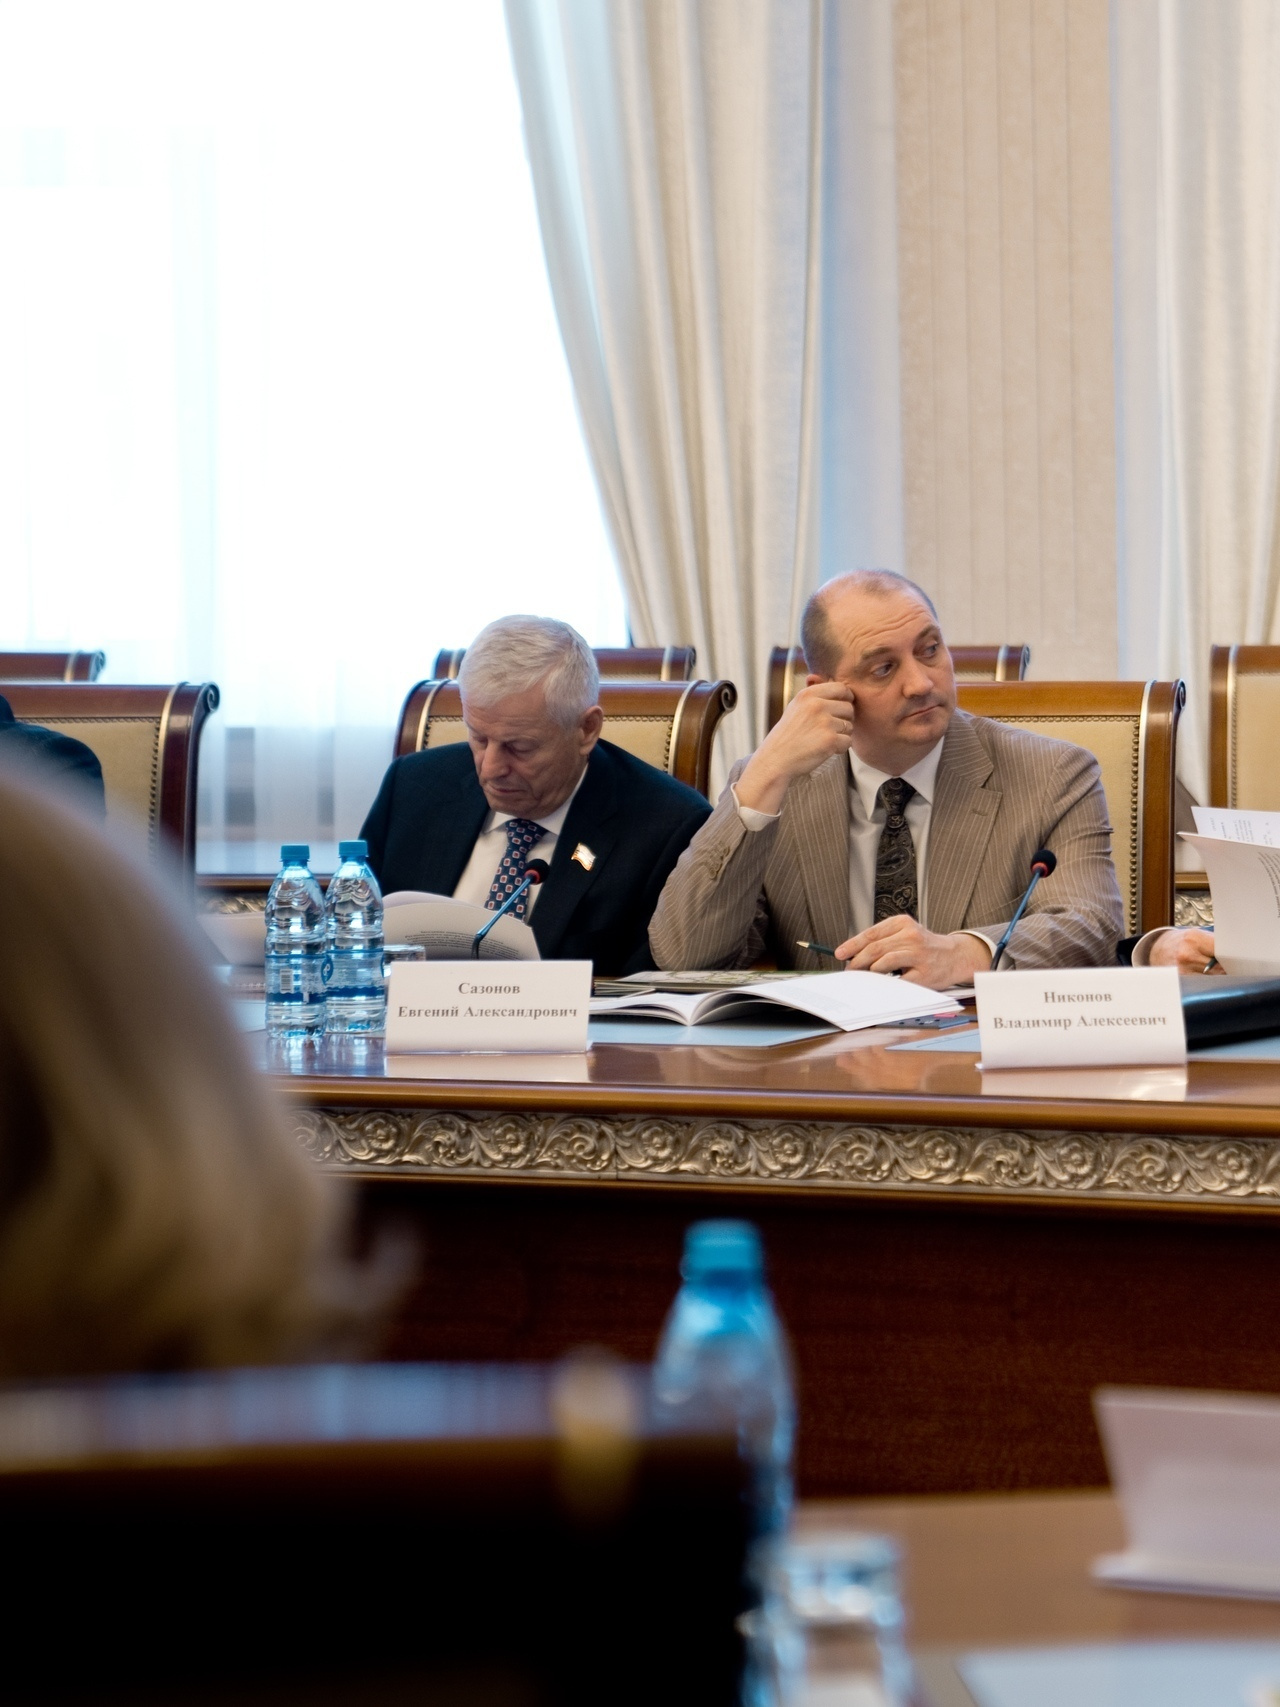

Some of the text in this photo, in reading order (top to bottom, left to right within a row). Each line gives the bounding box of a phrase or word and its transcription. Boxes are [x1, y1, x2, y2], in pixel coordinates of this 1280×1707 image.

[458, 982, 521, 995] Сазонов
[1043, 991, 1113, 1004] Никонов
[398, 1006, 577, 1020] Евгений Александрович
[993, 1015, 1167, 1030] Владимир Алексеевич
